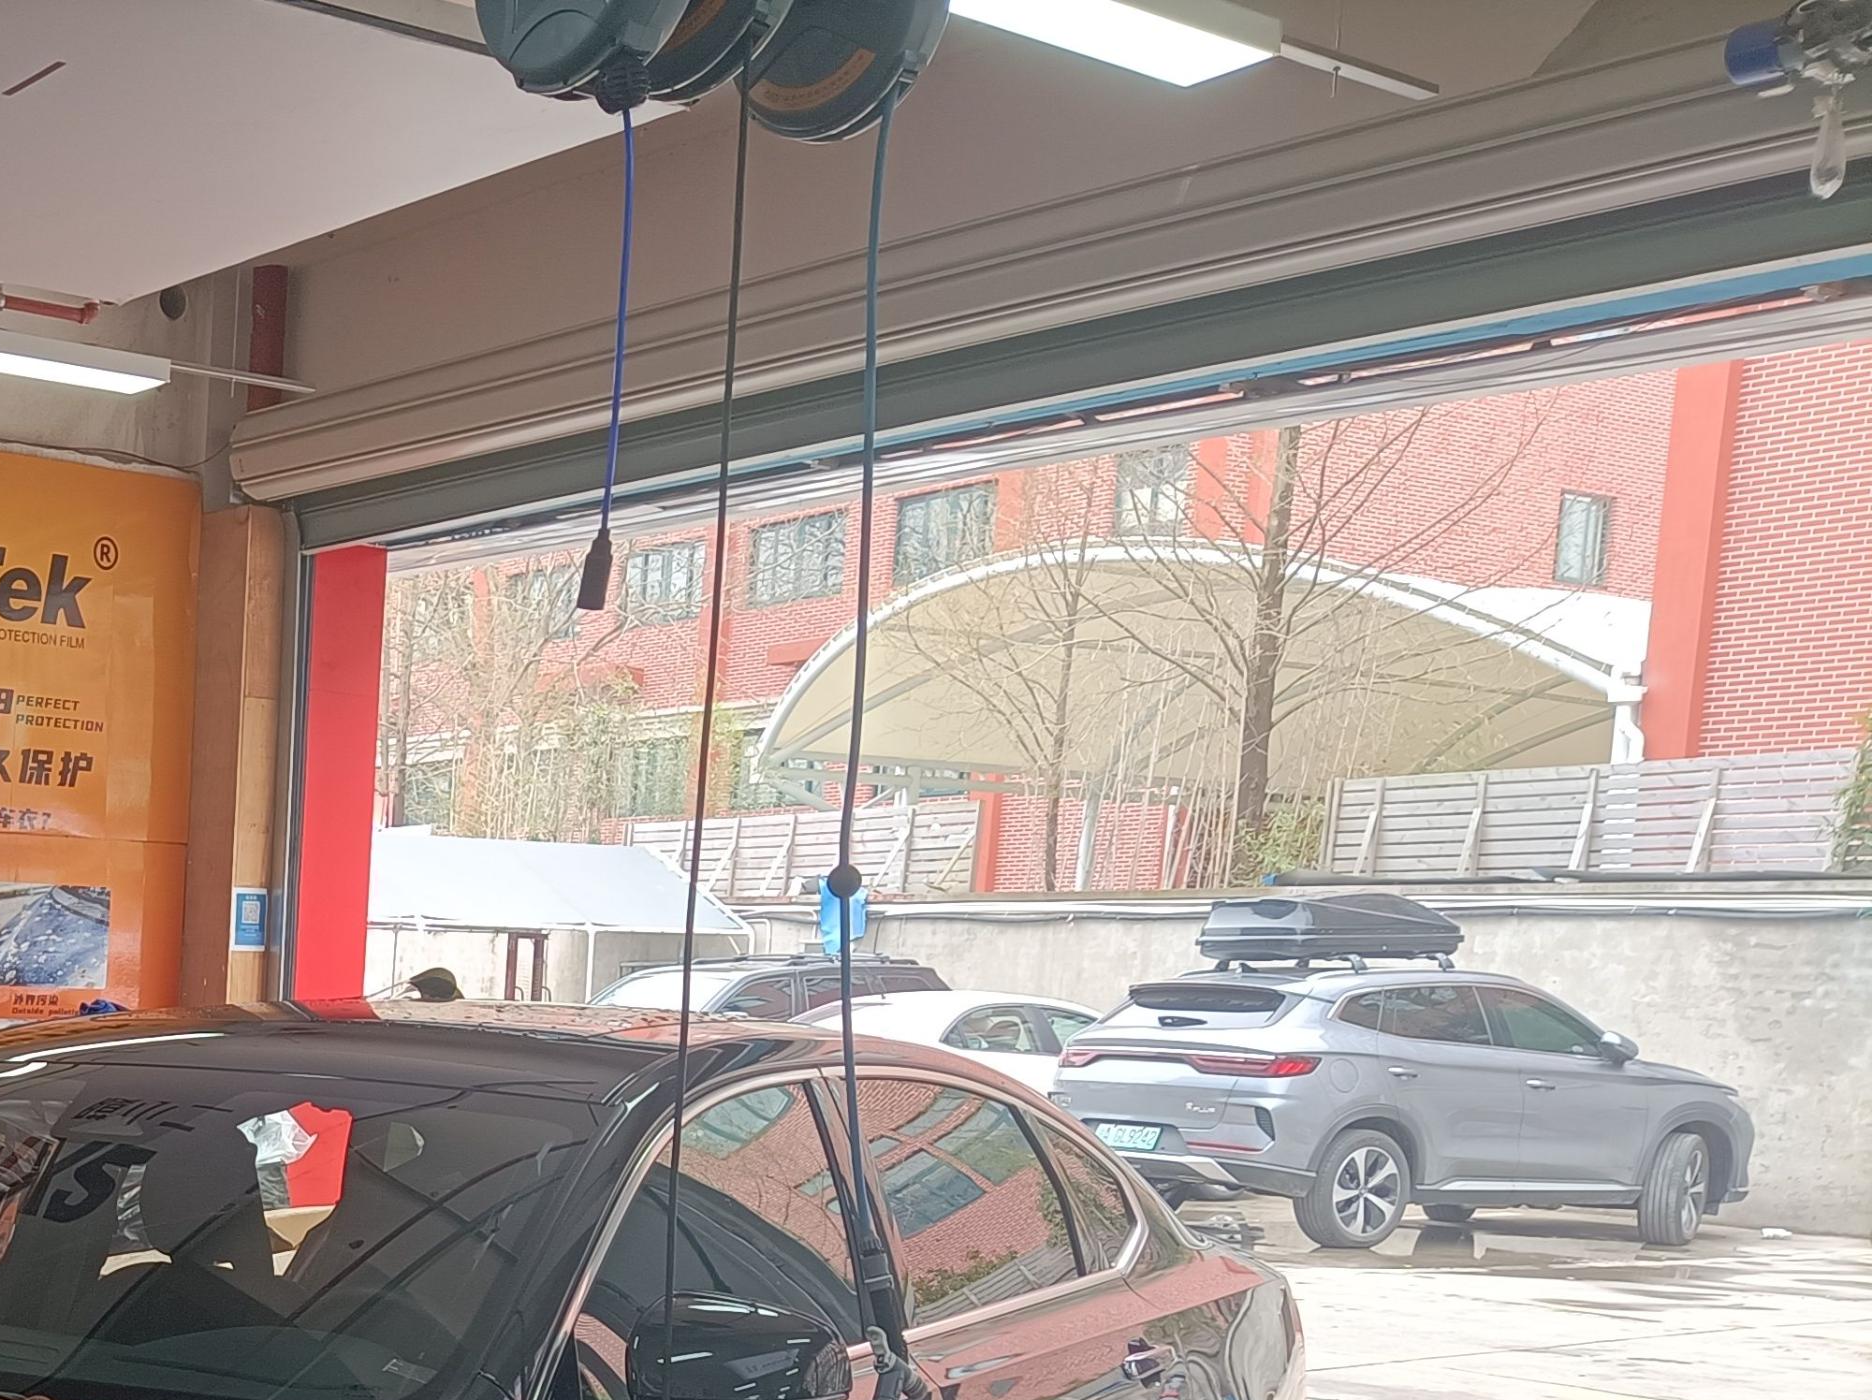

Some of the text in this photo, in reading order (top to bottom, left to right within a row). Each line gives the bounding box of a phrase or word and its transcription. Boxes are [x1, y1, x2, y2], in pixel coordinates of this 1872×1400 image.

[59, 635, 86, 649] FILM
[16, 694, 80, 712] PERFECT
[15, 713, 104, 733] PROTECTION
